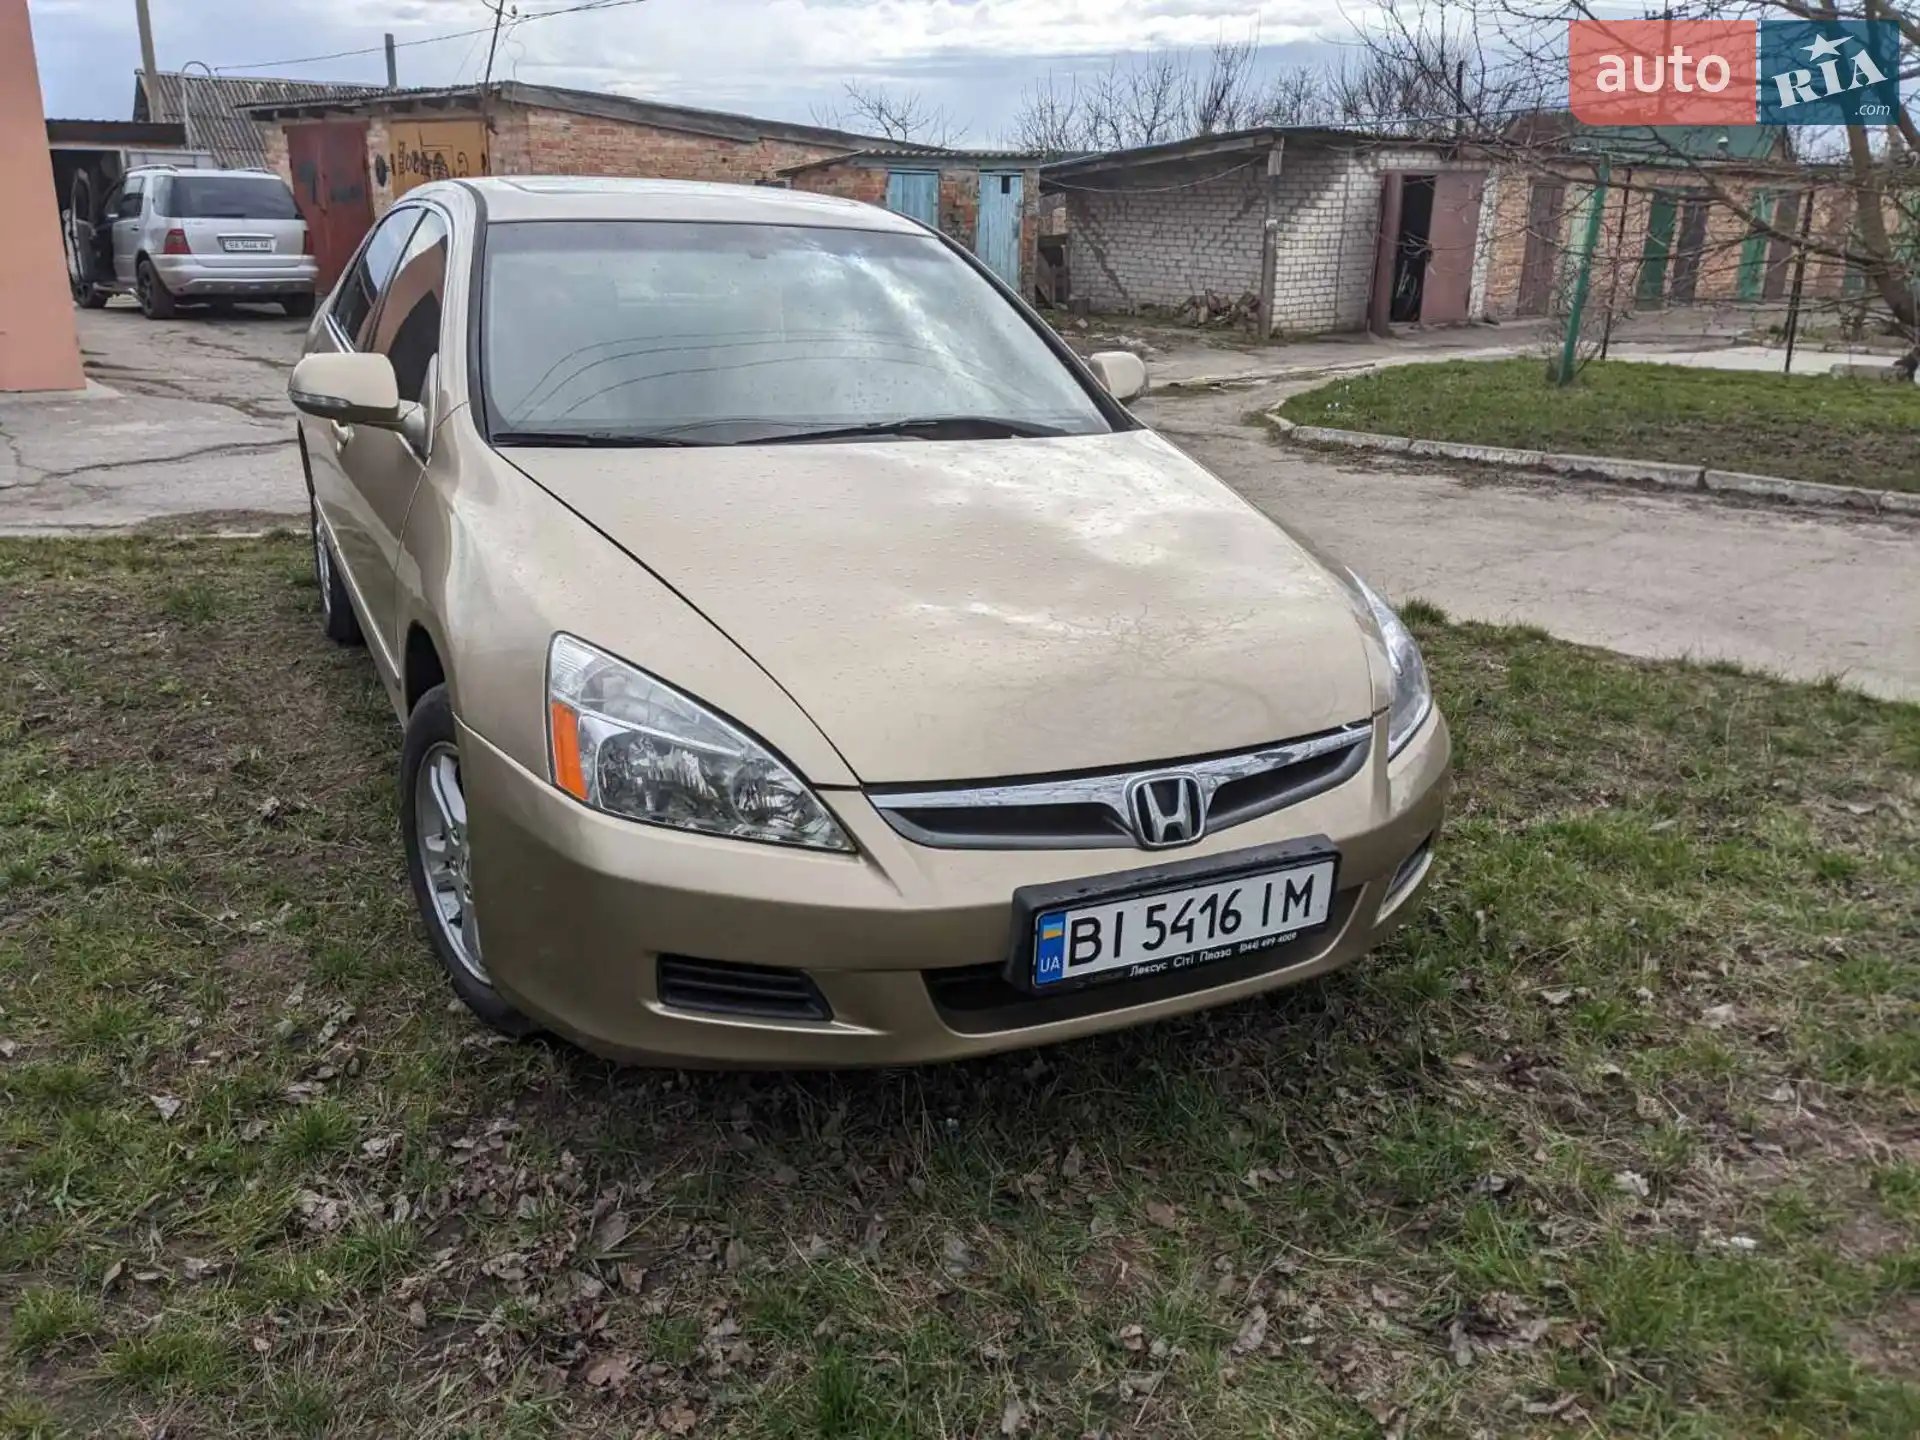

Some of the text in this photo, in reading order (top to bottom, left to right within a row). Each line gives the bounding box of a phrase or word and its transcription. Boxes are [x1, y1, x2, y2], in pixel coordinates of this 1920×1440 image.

[1068, 873, 1315, 967] BI 5416 IM
[1039, 956, 1061, 973] UA
[1129, 961, 1168, 977] Лексус
[1200, 948, 1232, 963] Плаза
